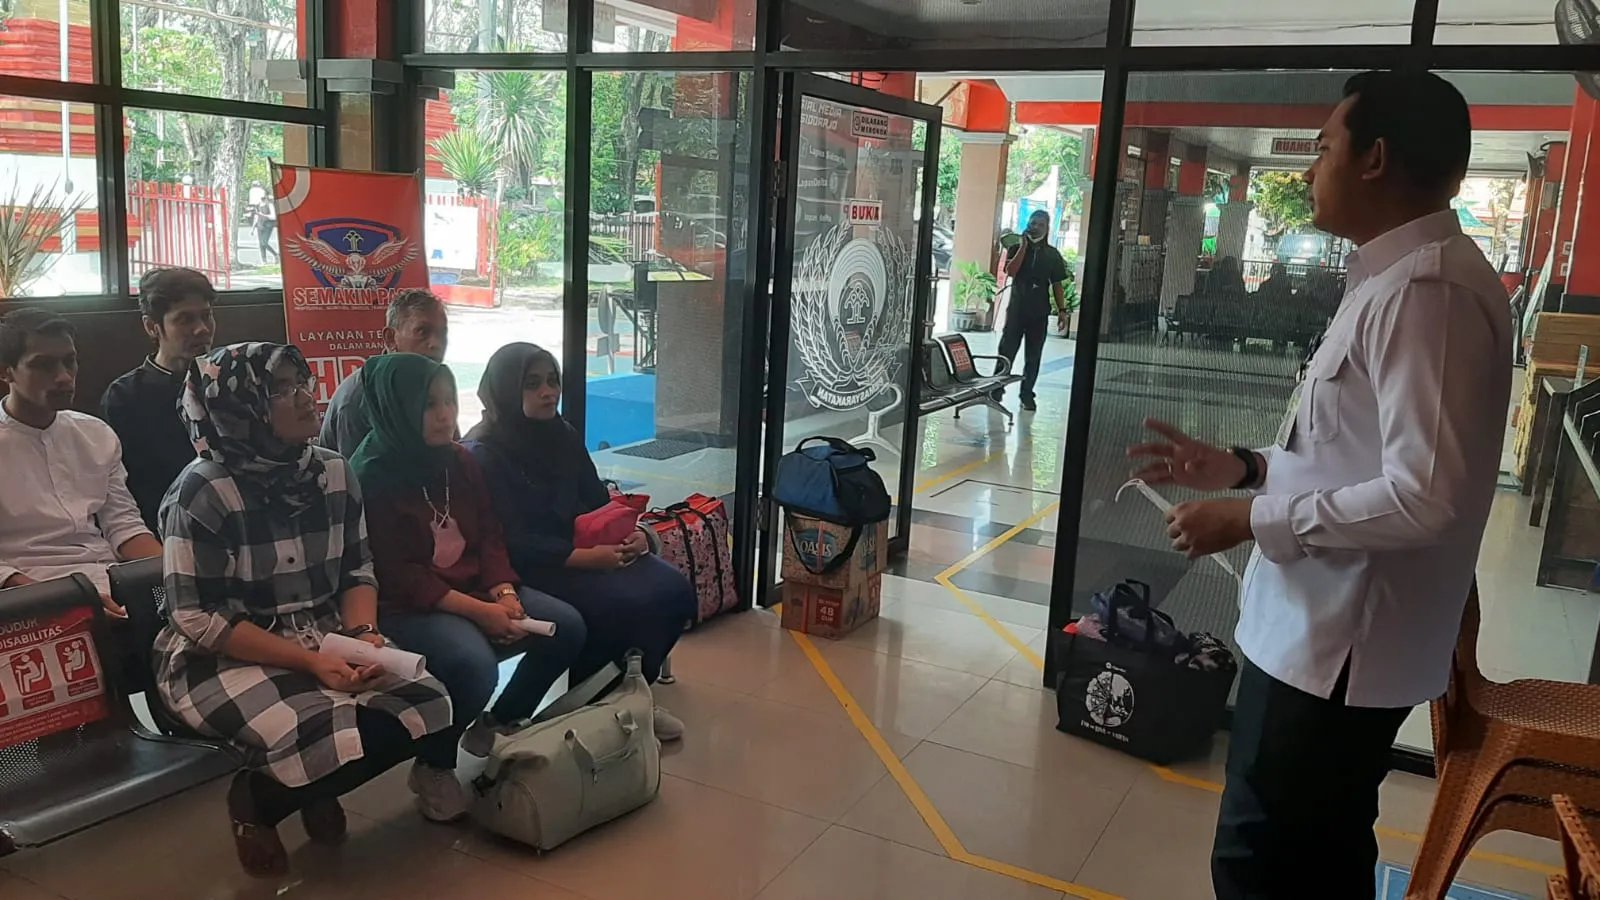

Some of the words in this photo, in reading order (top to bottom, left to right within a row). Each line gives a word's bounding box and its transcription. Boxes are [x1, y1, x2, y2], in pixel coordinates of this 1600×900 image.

[861, 116, 888, 127] DILARANG
[861, 126, 888, 136] MEROKOK
[1275, 141, 1311, 152] RUANG
[851, 205, 880, 221] BUKA
[293, 287, 372, 306] SEMAKIN
[377, 287, 404, 306] PA
[300, 331, 364, 342] LAYANAN
[329, 342, 363, 351] DALAM
[800, 540, 832, 557] OASIS
